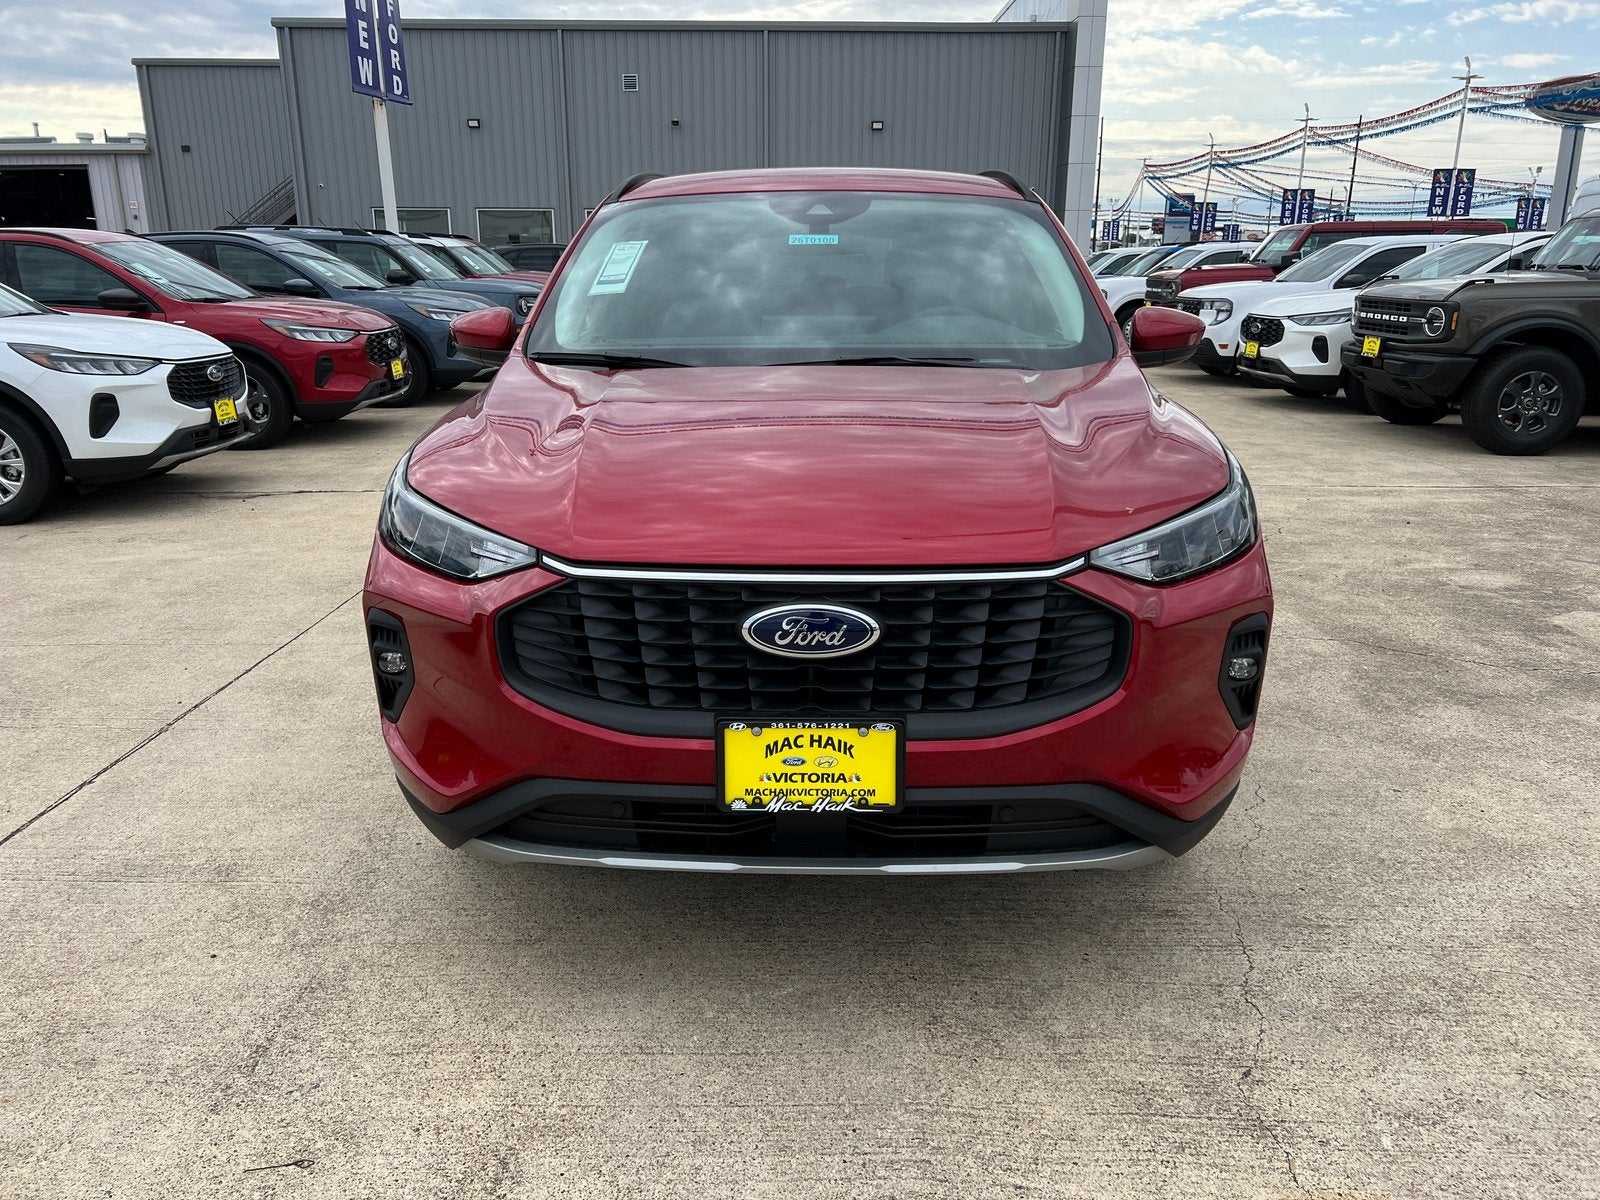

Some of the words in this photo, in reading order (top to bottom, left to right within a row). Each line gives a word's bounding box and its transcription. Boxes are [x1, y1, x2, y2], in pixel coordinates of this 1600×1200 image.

[1432, 187, 1445, 215] NEW
[1456, 187, 1467, 215] FORD
[1191, 213, 1199, 231] NEW
[1283, 203, 1292, 225] NEW
[1301, 203, 1309, 225] FORD
[1516, 211, 1526, 230] NEW
[791, 236, 835, 244] 26T0100
[1360, 311, 1408, 323] BRONCO
[774, 616, 848, 646] Ford
[765, 734, 804, 759] MAC
[809, 734, 855, 759] HAIK
[773, 772, 848, 784] VICTORIA
[765, 796, 805, 813] Mac
